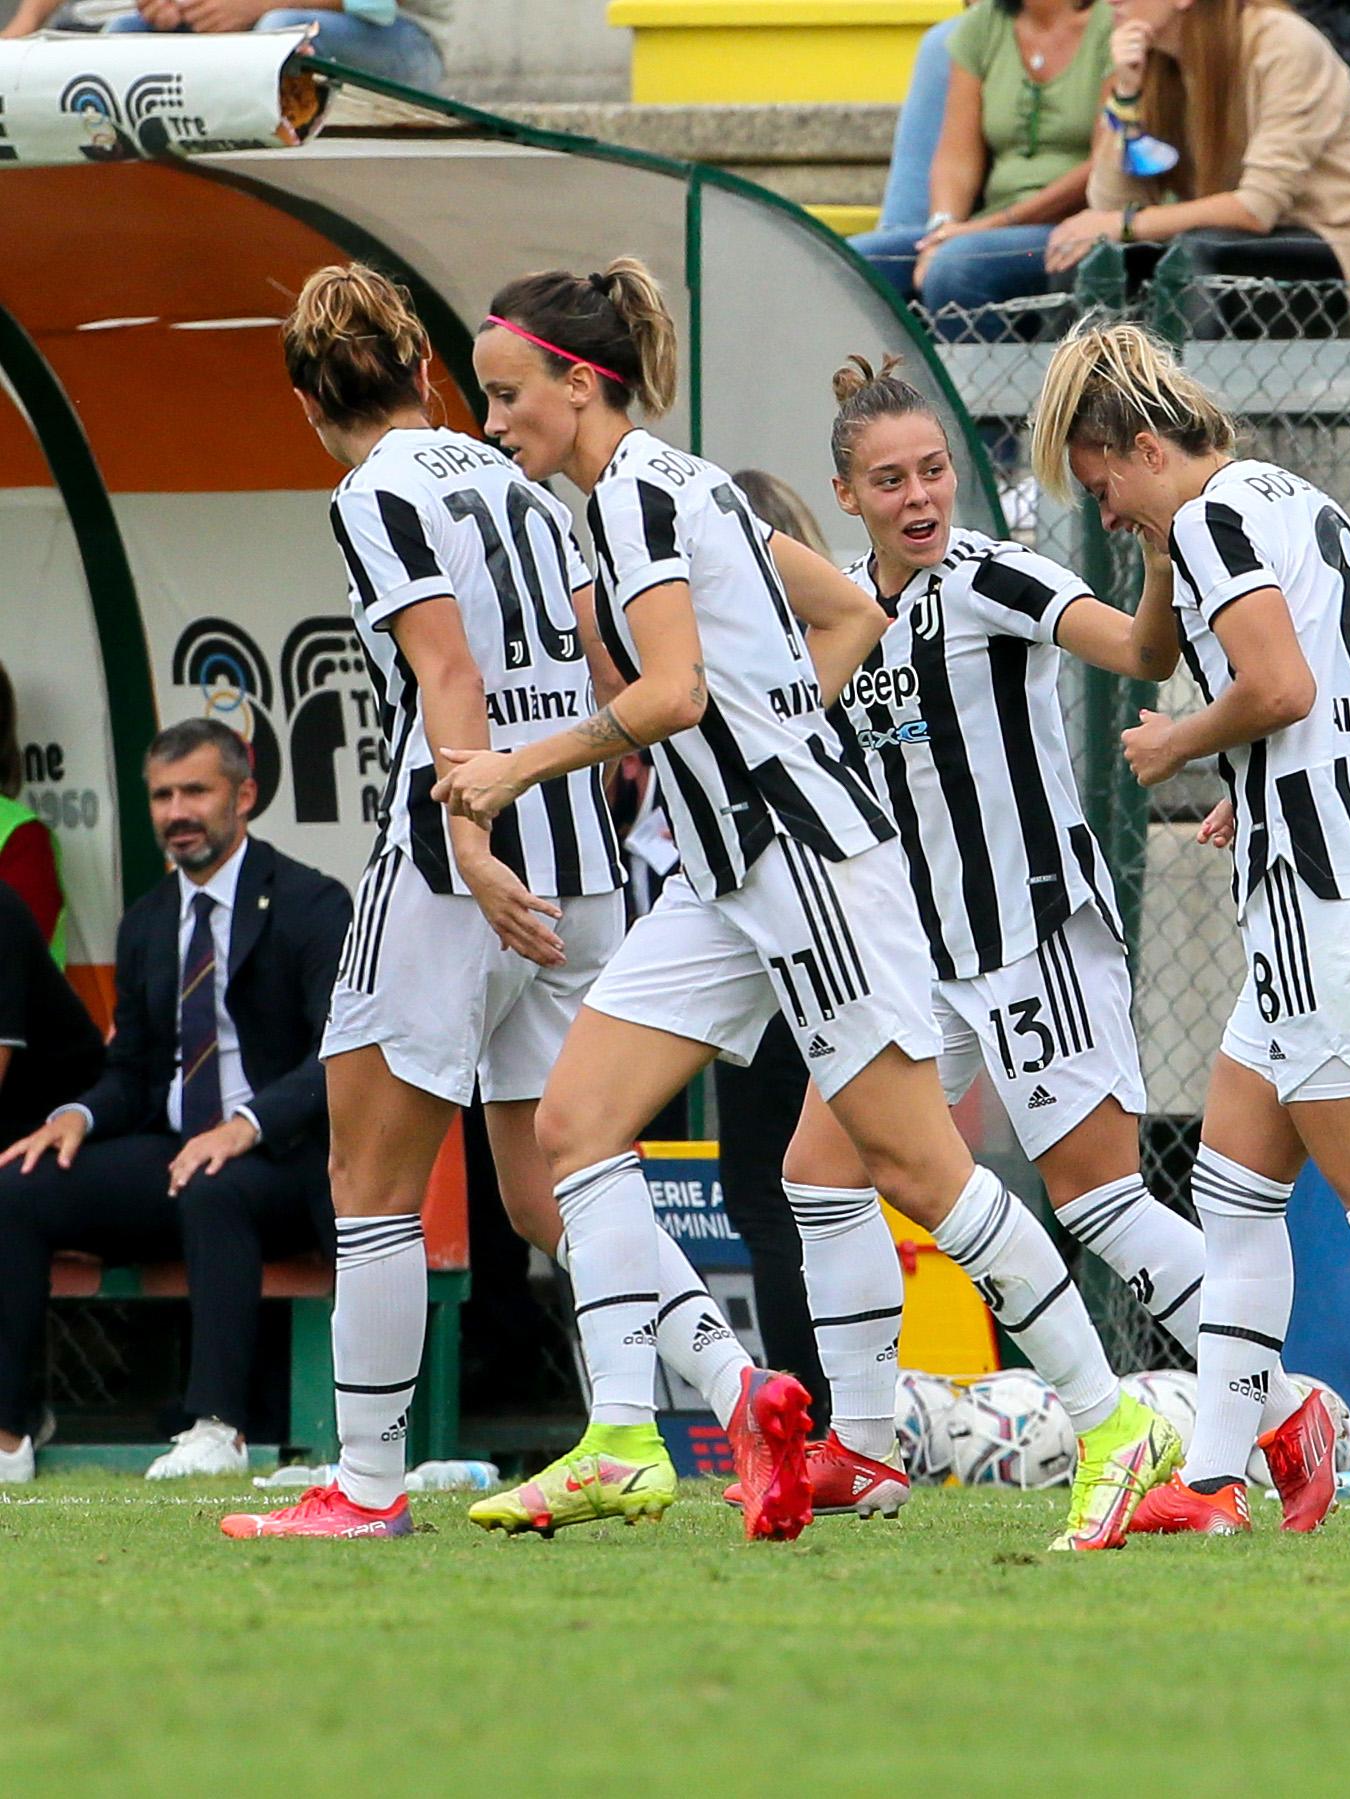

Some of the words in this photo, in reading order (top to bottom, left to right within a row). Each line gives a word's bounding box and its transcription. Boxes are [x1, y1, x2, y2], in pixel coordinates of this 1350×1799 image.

[442, 481, 585, 671] 10
[769, 949, 835, 1027] 11
[1254, 952, 1280, 1024] 8
[990, 997, 1054, 1079] 13
[650, 1181, 706, 1208] ERIE
[655, 1212, 741, 1240] MMINIL
